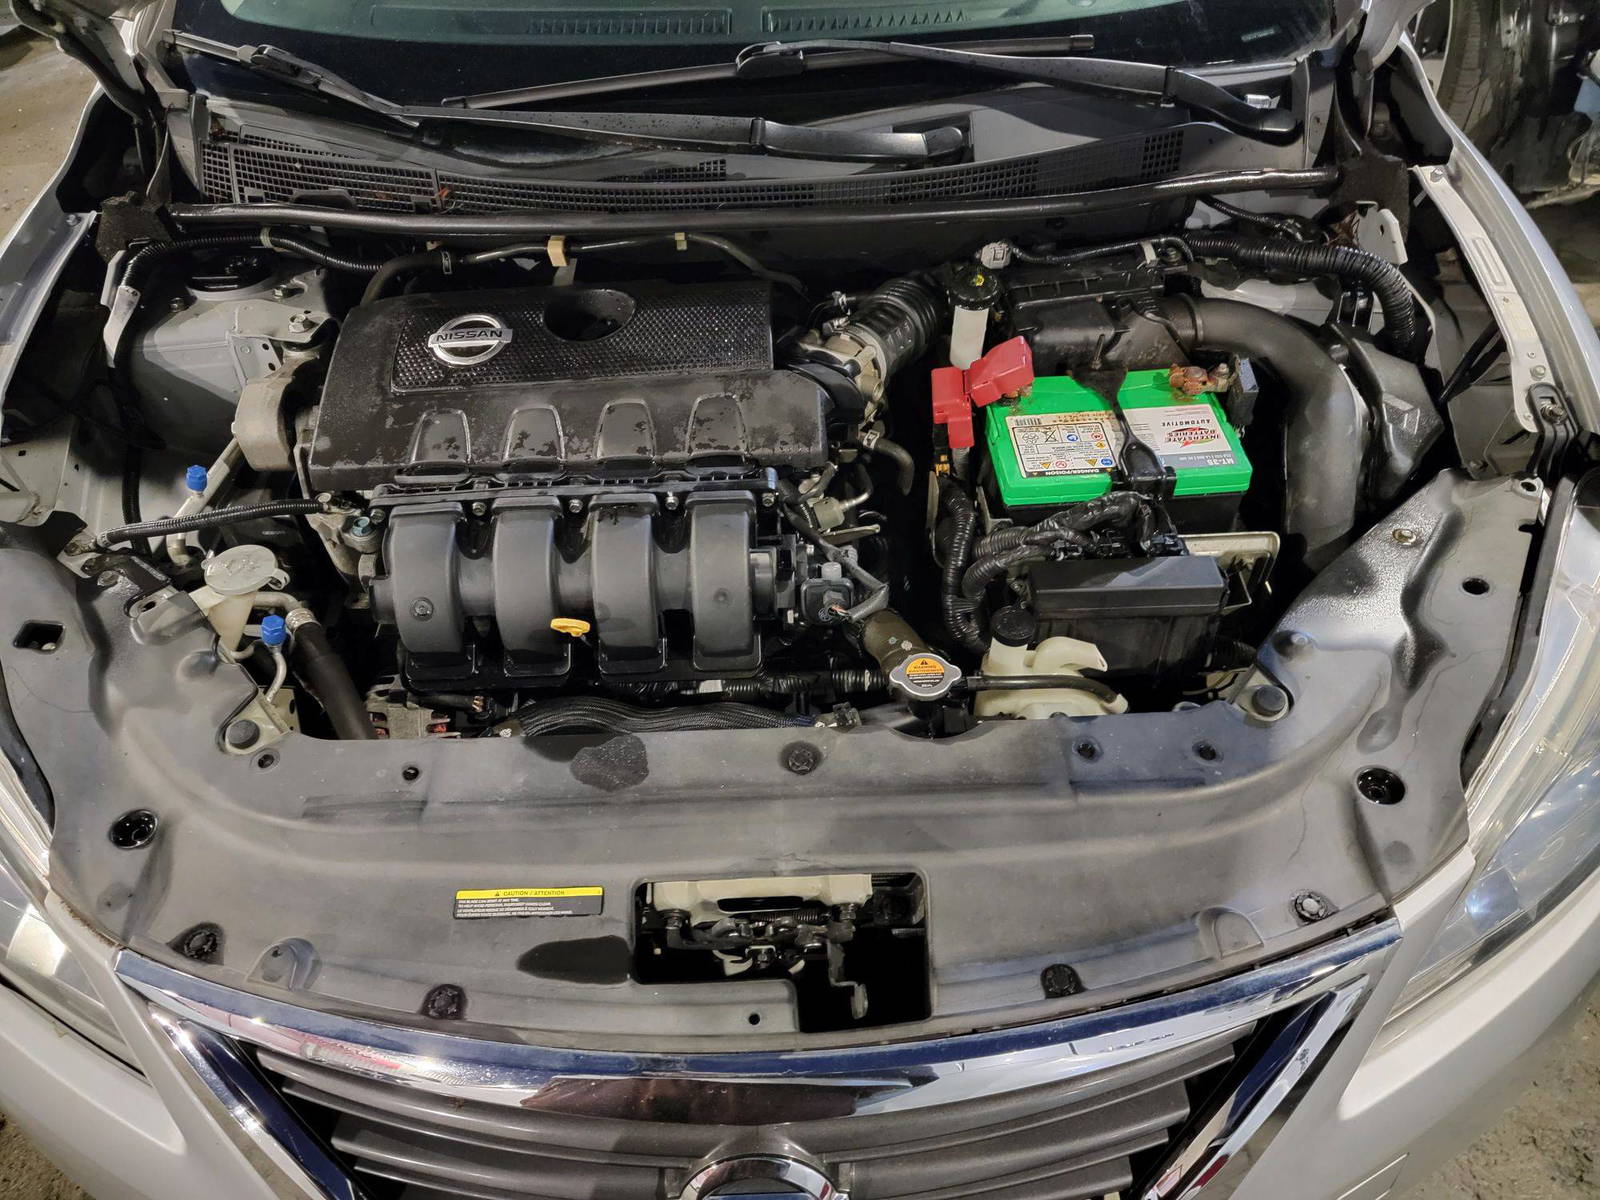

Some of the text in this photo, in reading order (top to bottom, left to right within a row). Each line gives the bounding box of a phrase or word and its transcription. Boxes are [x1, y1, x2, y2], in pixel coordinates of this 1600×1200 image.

[436, 330, 503, 342] NISSAN
[1162, 419, 1211, 427] AUTOMOTIVE
[1168, 429, 1216, 437] BATTERIES
[1167, 434, 1219, 442] INTERSTATE
[1045, 468, 1100, 476] DANGER/POISON
